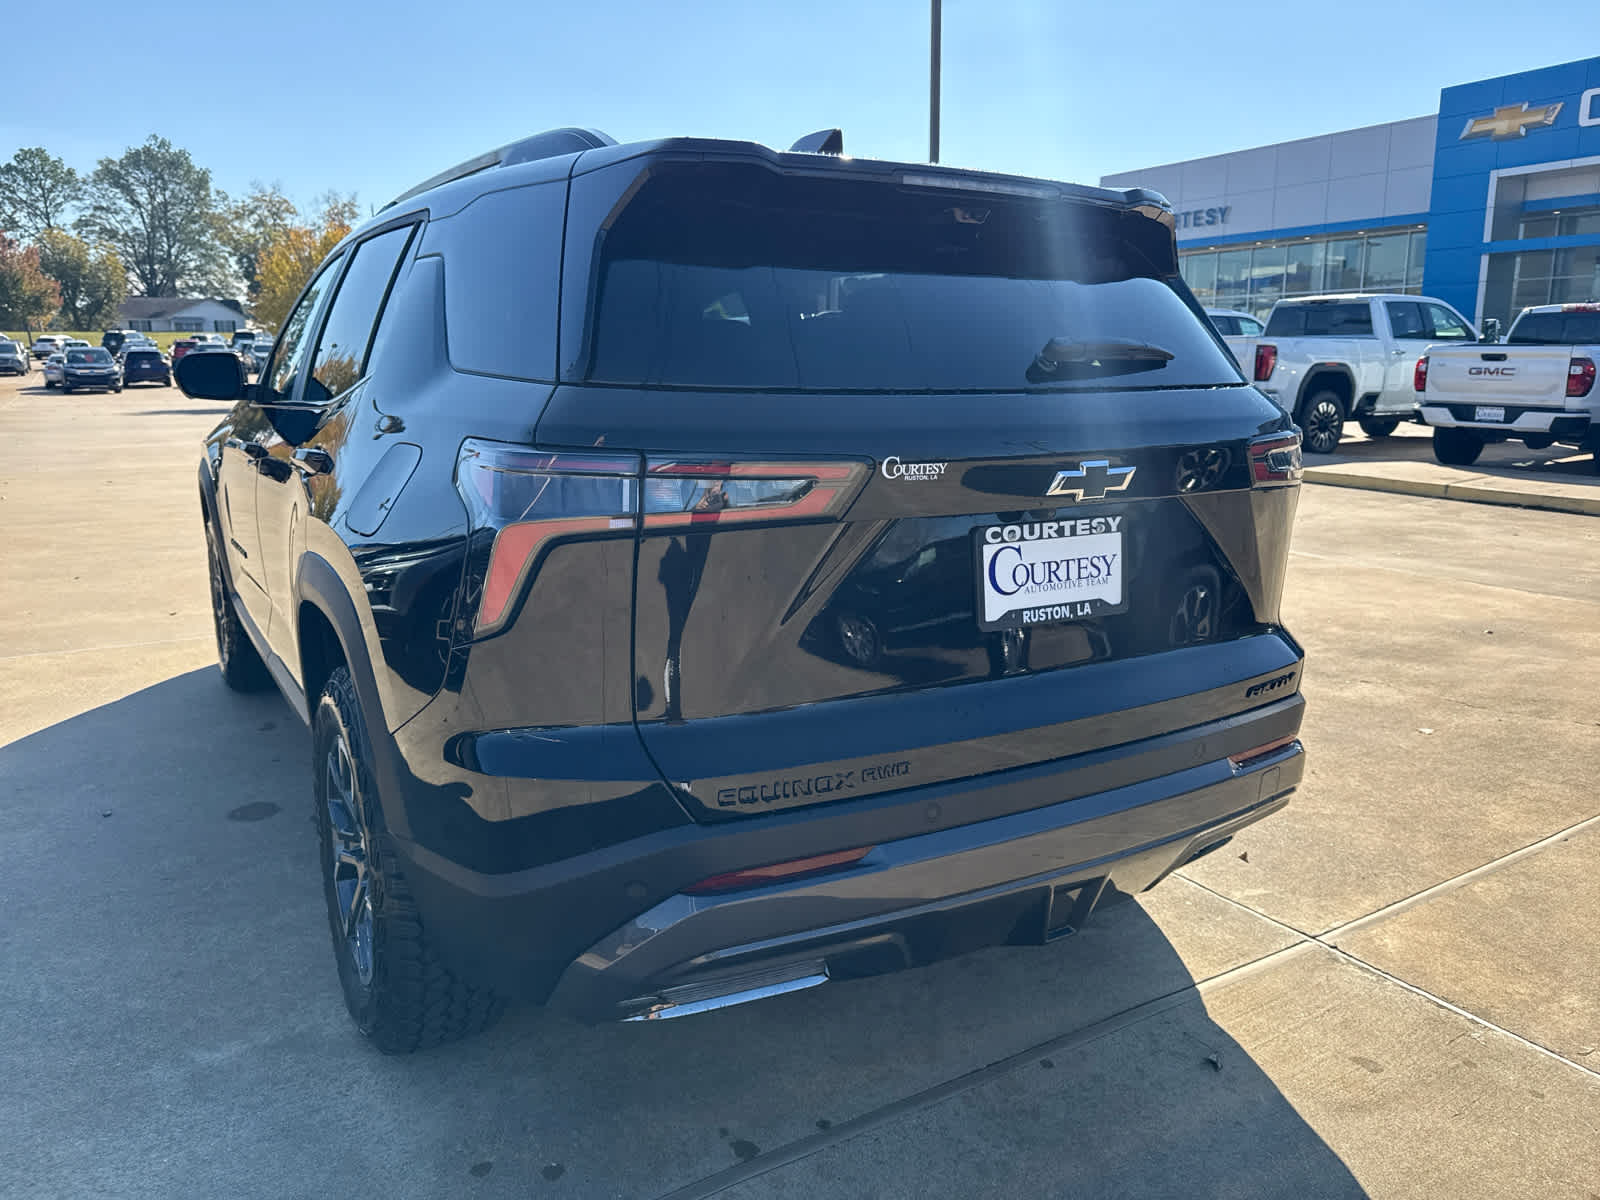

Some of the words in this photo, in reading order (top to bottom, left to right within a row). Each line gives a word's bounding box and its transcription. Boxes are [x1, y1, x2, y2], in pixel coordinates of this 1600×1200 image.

[1468, 367, 1516, 377] GMC
[881, 456, 948, 480] COURTESY
[985, 516, 1122, 544] COURTESY
[988, 545, 1117, 596] COURTESY
[1024, 579, 1083, 594] AUTOMOTIVE
[1086, 576, 1109, 587] TEAM
[1022, 604, 1073, 624] RUSTON,
[1077, 602, 1092, 616] LA
[717, 770, 854, 807] EQUINOX
